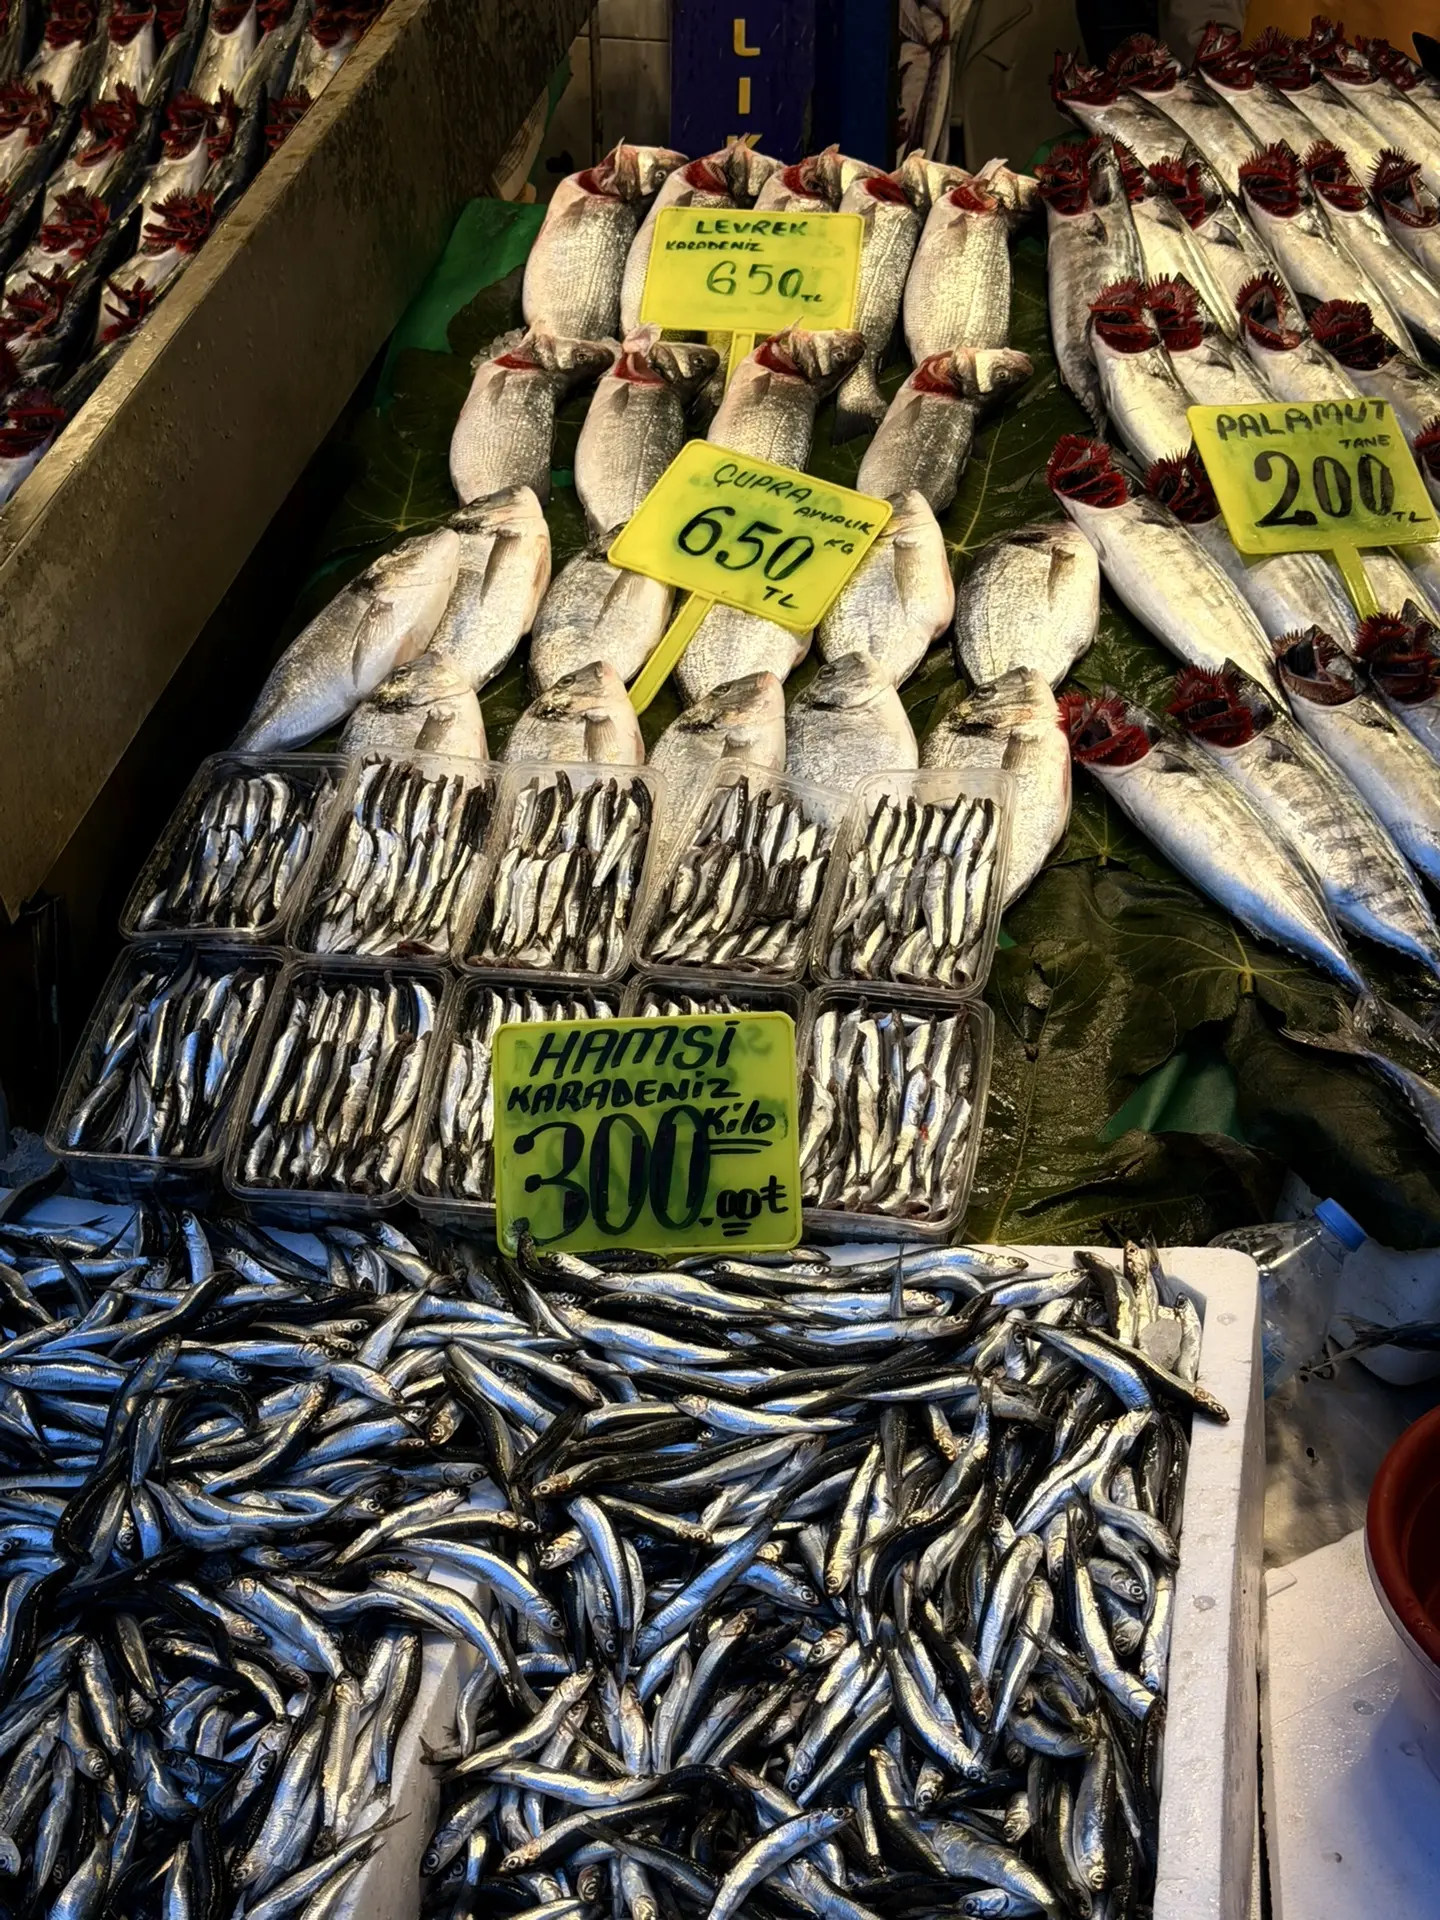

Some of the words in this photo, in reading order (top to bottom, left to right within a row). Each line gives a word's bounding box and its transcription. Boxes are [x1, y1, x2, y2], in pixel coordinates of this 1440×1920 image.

[695, 219, 808, 236] LEVREK
[706, 260, 804, 298] 650
[801, 294, 823, 302] TL
[1216, 401, 1389, 440] PALAMUT
[1339, 434, 1391, 449] TANE
[713, 463, 812, 504] ÇUPRA
[1254, 450, 1395, 527] 200
[1393, 511, 1431, 523] TL
[678, 506, 815, 581] 650
[824, 537, 854, 555] KG
[763, 586, 798, 609] TL
[529, 1020, 740, 1080] HAMSİ
[507, 1071, 741, 1116] KARADENİZ
[705, 1100, 776, 1134] Kilo
